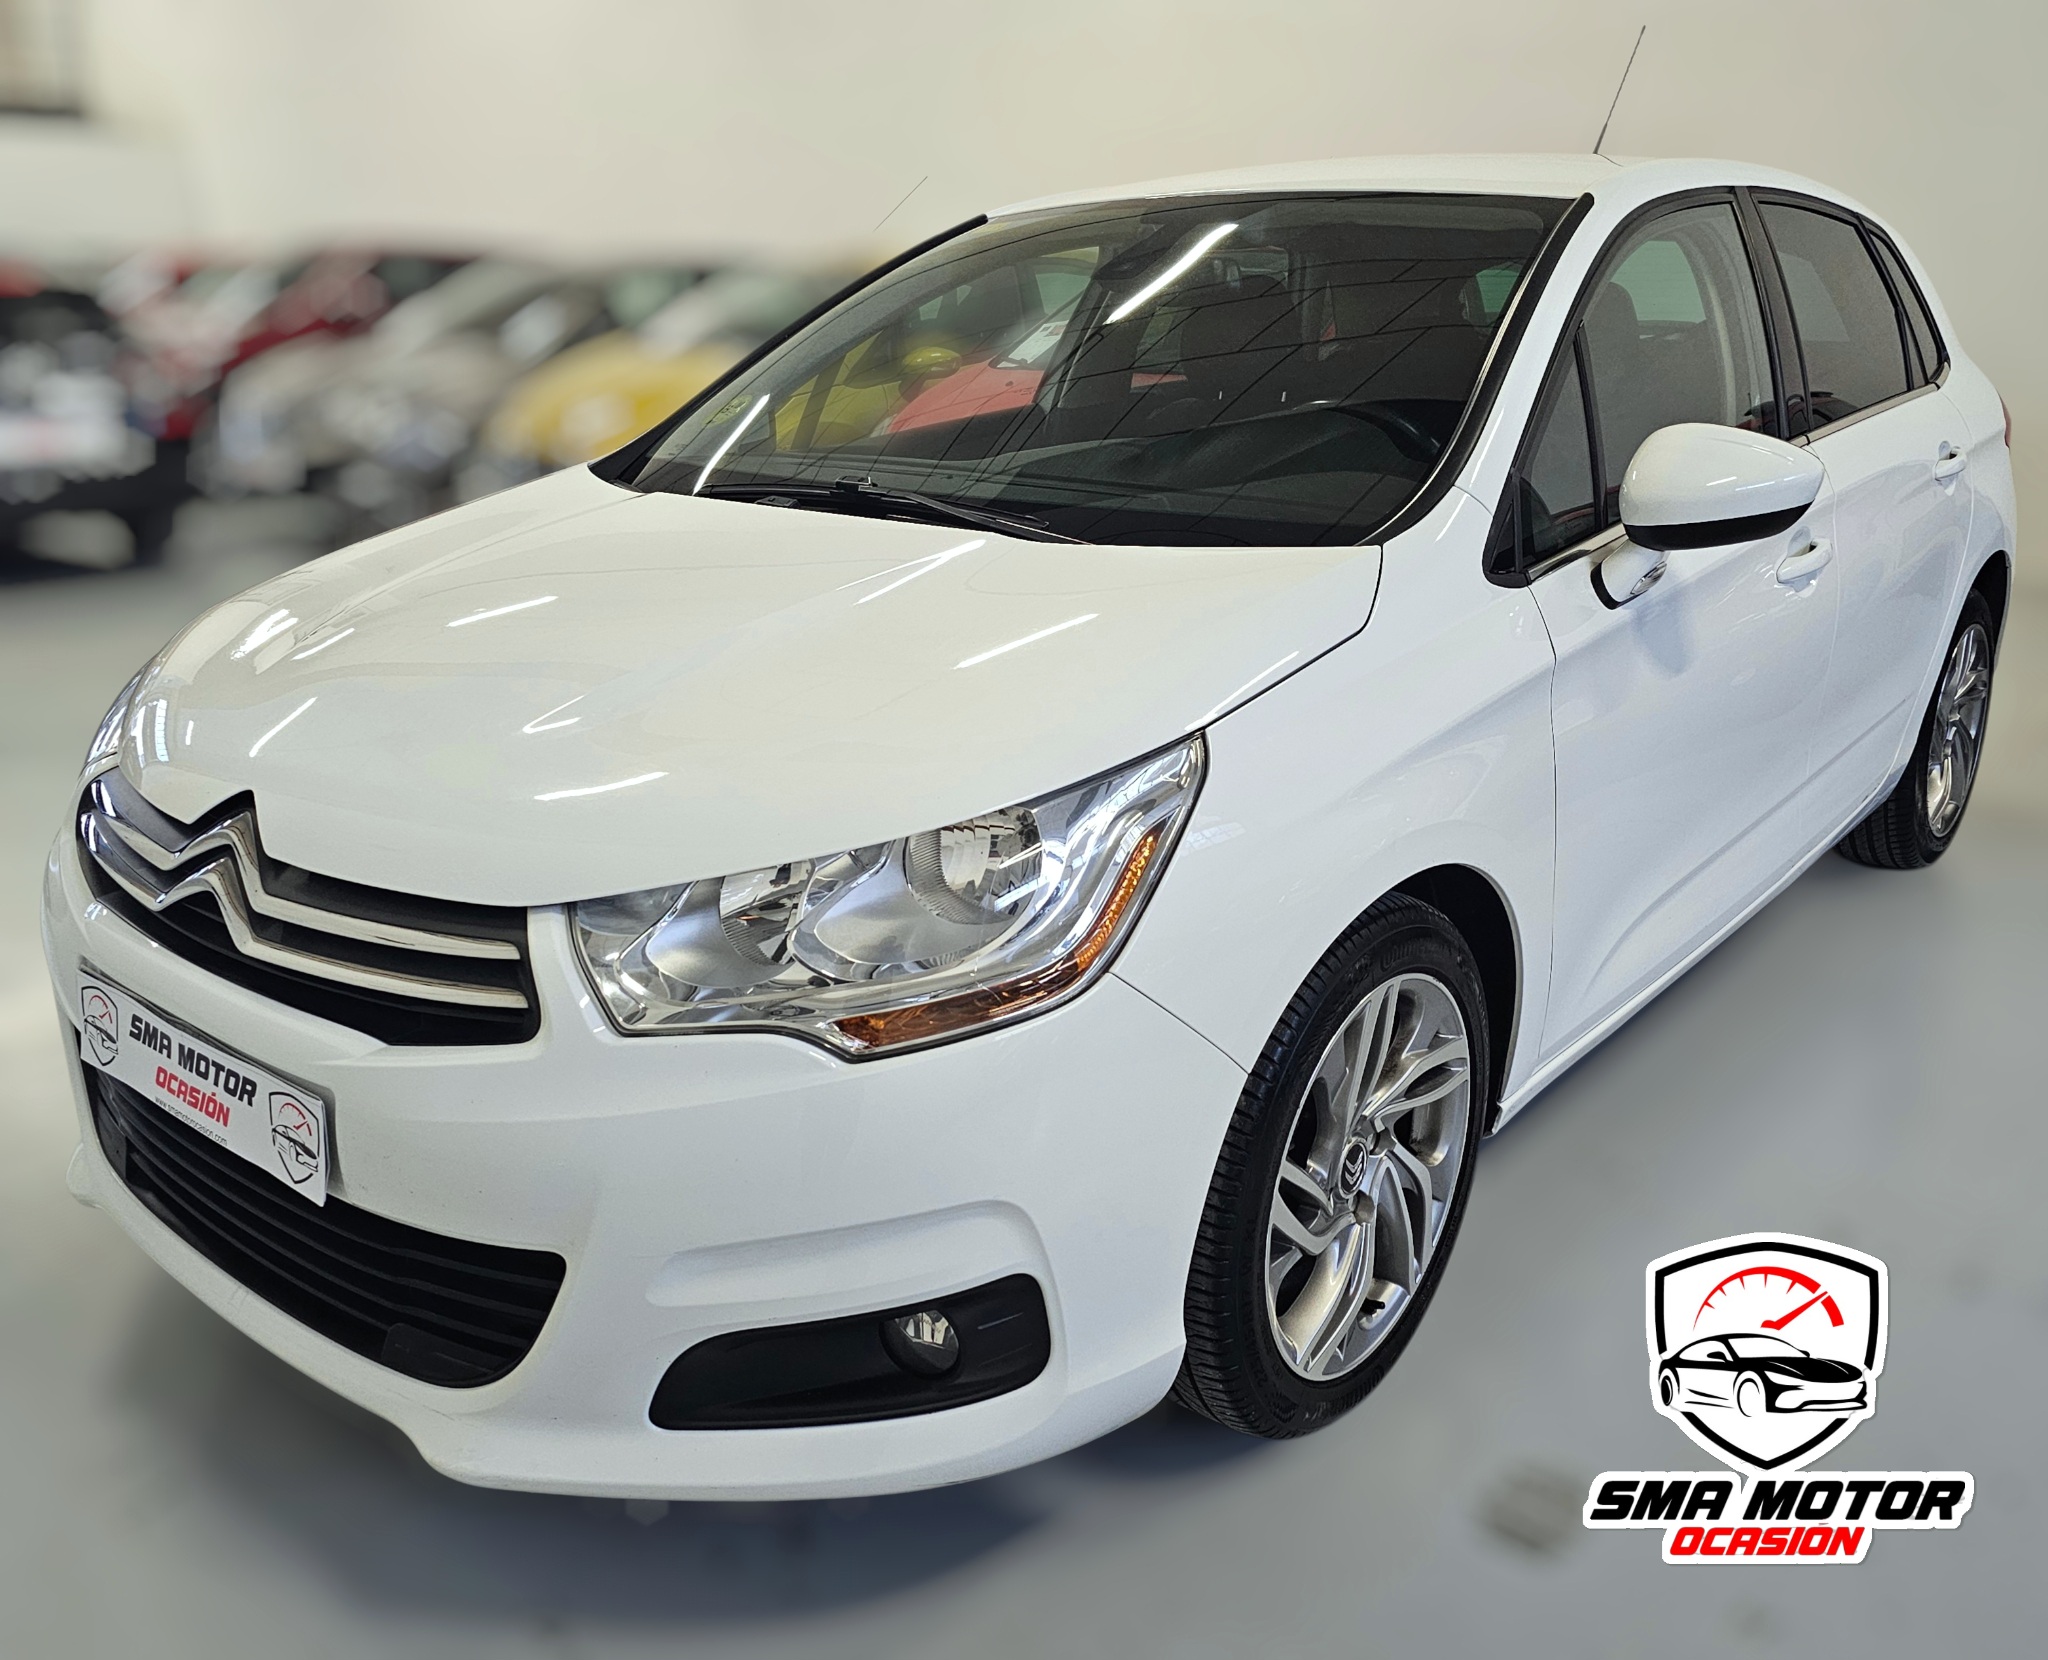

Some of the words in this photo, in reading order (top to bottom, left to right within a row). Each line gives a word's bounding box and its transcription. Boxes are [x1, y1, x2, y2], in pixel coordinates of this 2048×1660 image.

[129, 1013, 172, 1060] SMA
[177, 1042, 258, 1108] MOTOR
[155, 1066, 230, 1128] OCASIÓN
